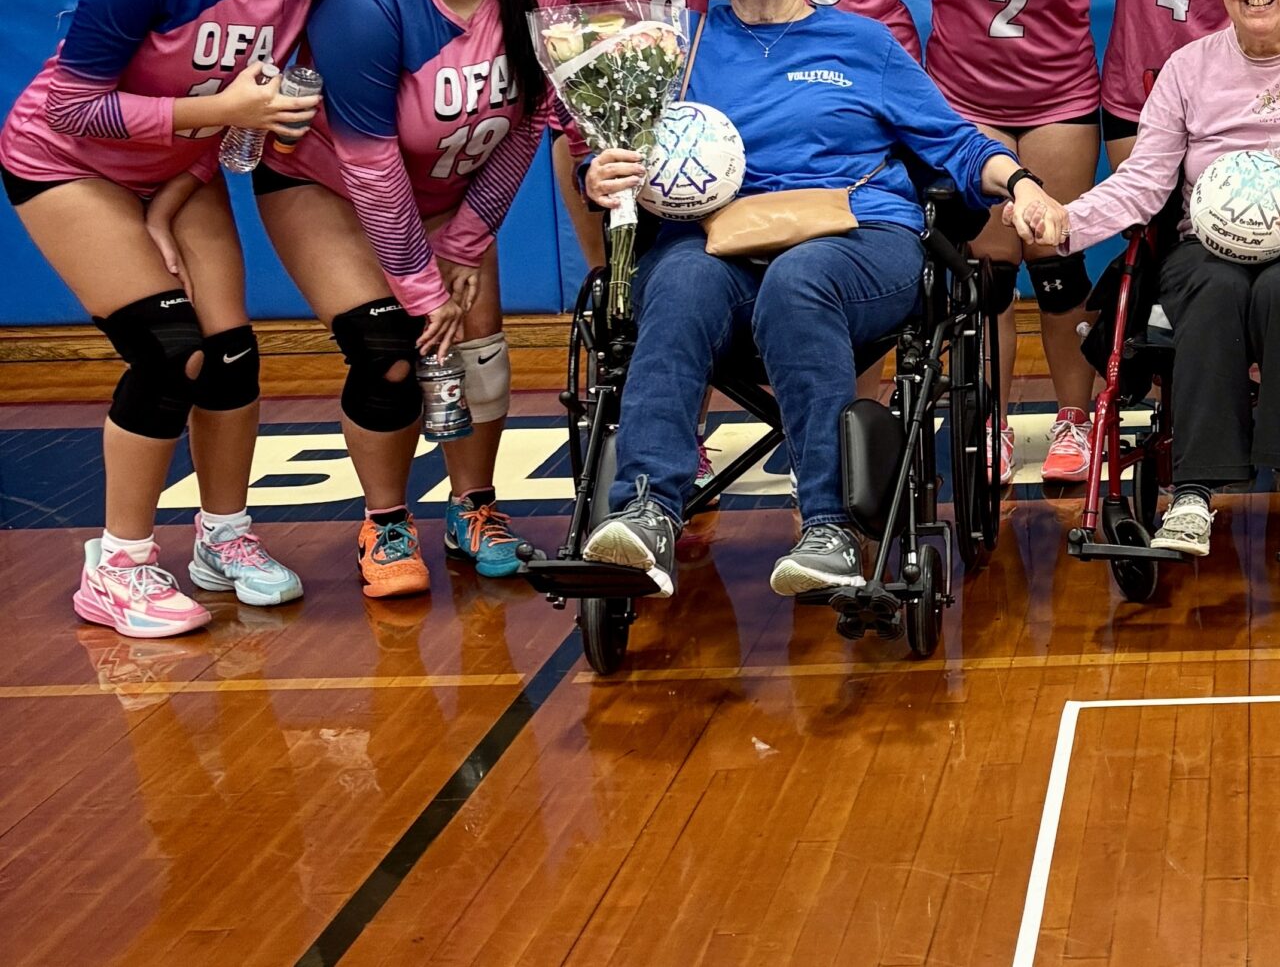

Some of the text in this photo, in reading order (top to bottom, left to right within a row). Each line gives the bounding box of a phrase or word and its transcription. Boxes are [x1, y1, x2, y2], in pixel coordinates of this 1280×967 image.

[192, 20, 275, 72] OFA
[434, 54, 519, 122] OFA
[787, 70, 844, 82] VOLLEYBALL
[430, 115, 512, 179] 19
[1204, 234, 1259, 262] Wilson
[1210, 222, 1265, 246] SOFTPLAY
